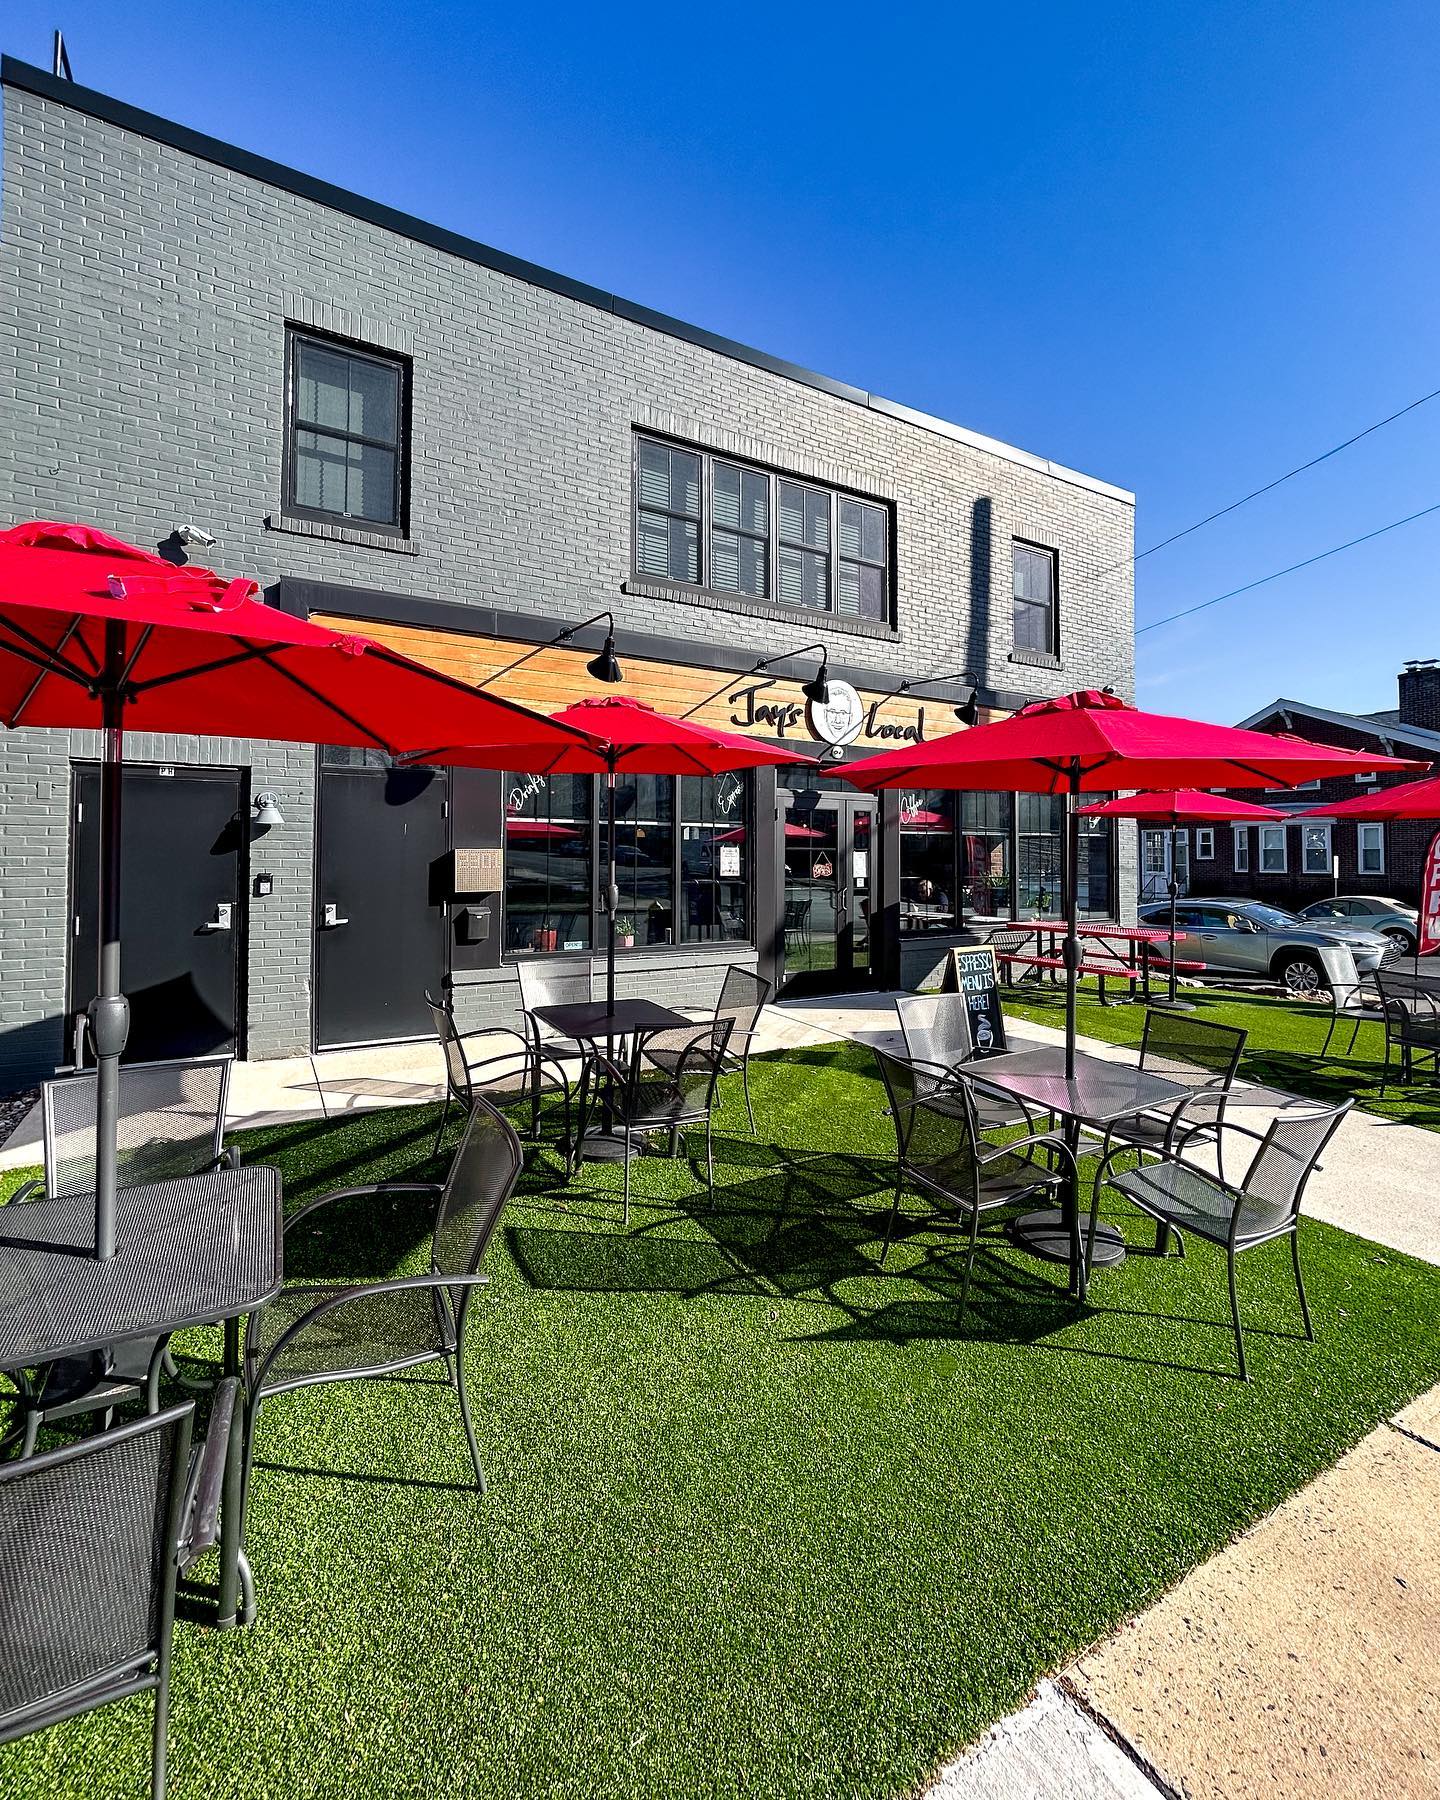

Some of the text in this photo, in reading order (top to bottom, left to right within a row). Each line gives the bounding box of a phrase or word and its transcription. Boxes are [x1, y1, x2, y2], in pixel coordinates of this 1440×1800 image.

[728, 679, 926, 744] Jay's Local
[901, 794, 923, 824] Coffee
[959, 953, 992, 972] ESPRESSO
[962, 973, 995, 991] MENU IS
[968, 993, 989, 1011] HERE!
